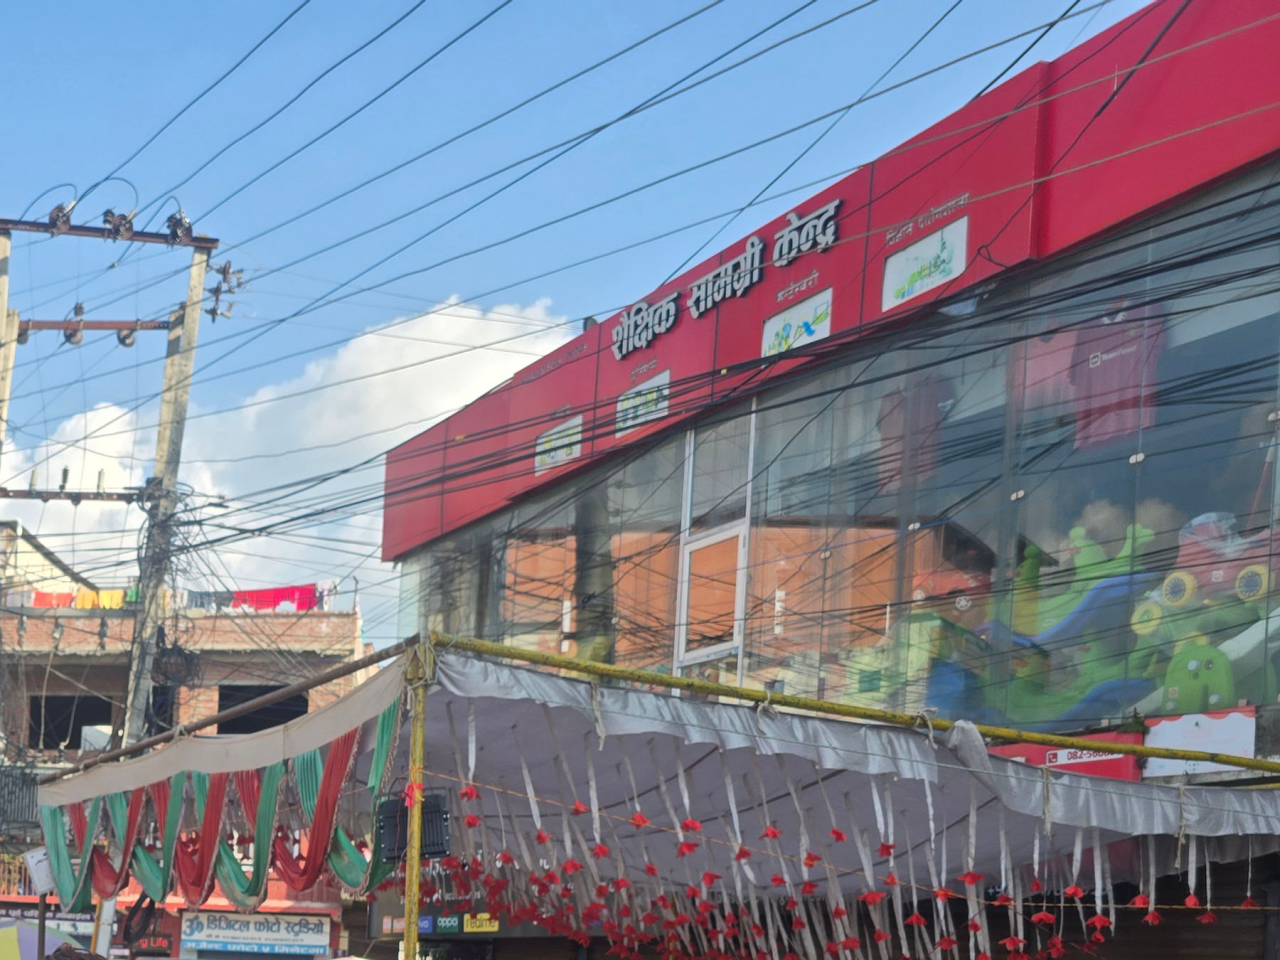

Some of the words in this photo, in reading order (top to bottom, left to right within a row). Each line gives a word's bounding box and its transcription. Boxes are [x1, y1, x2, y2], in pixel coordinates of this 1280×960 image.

[611, 292, 682, 361] शैक्षिक
[686, 236, 764, 319] सामग्री
[773, 198, 844, 267] केन्द्र
[206, 915, 251, 933] डिजिटल
[253, 917, 281, 933] फोटो
[284, 918, 325, 937] स्टुडियो
[437, 917, 459, 928] oppo
[465, 915, 496, 929] realme
